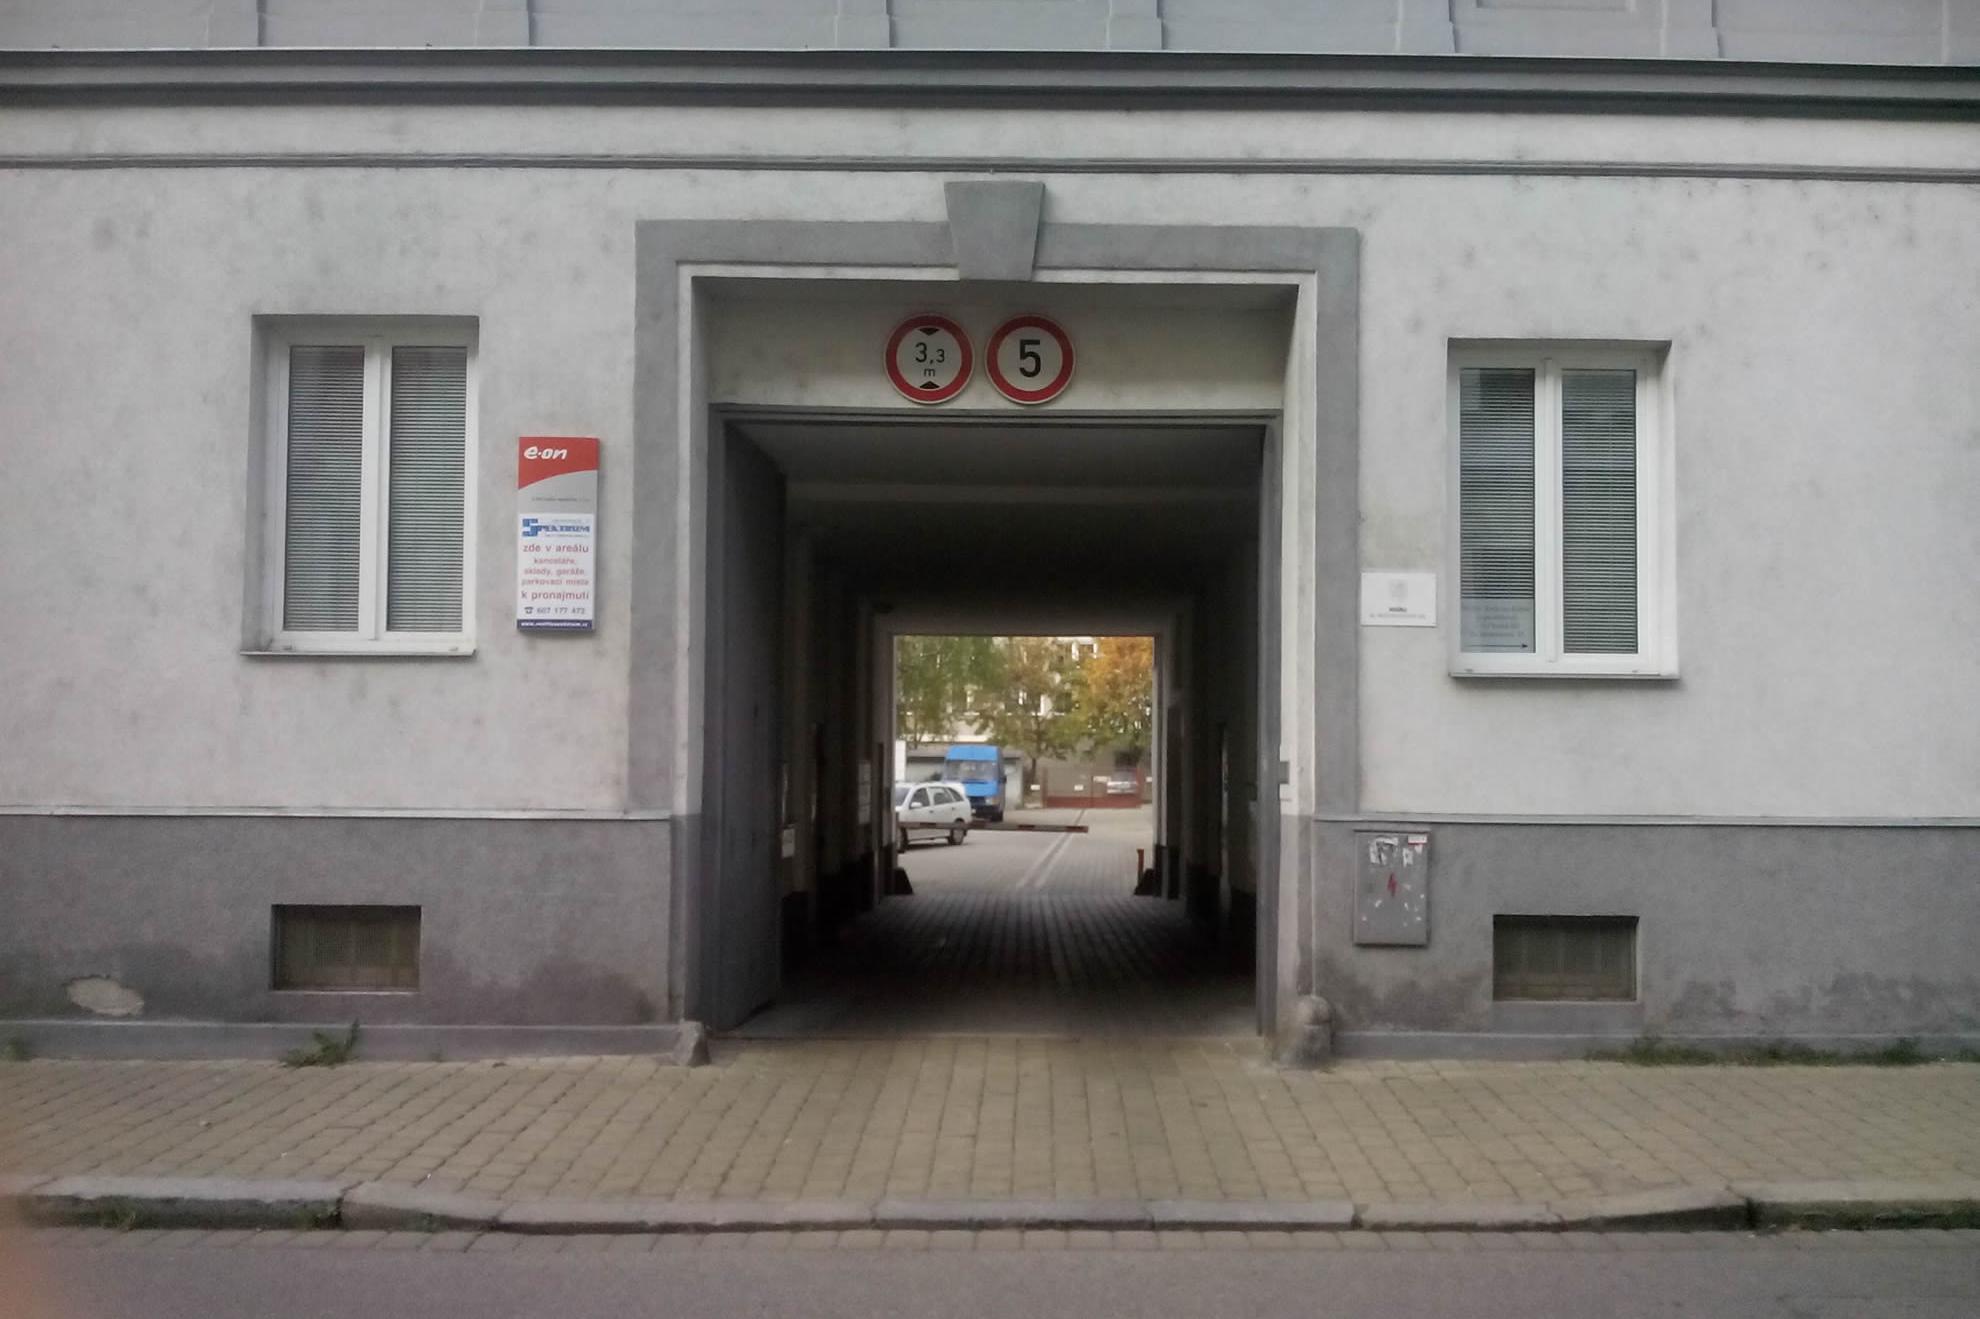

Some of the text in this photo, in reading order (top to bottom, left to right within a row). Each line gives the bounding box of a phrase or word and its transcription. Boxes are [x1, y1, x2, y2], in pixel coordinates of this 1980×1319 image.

[914, 342, 945, 365] 3,3
[1018, 339, 1042, 378] 5
[923, 367, 936, 377] m
[523, 543, 542, 552] zde
[555, 543, 589, 552] areálu
[520, 590, 528, 599] k
